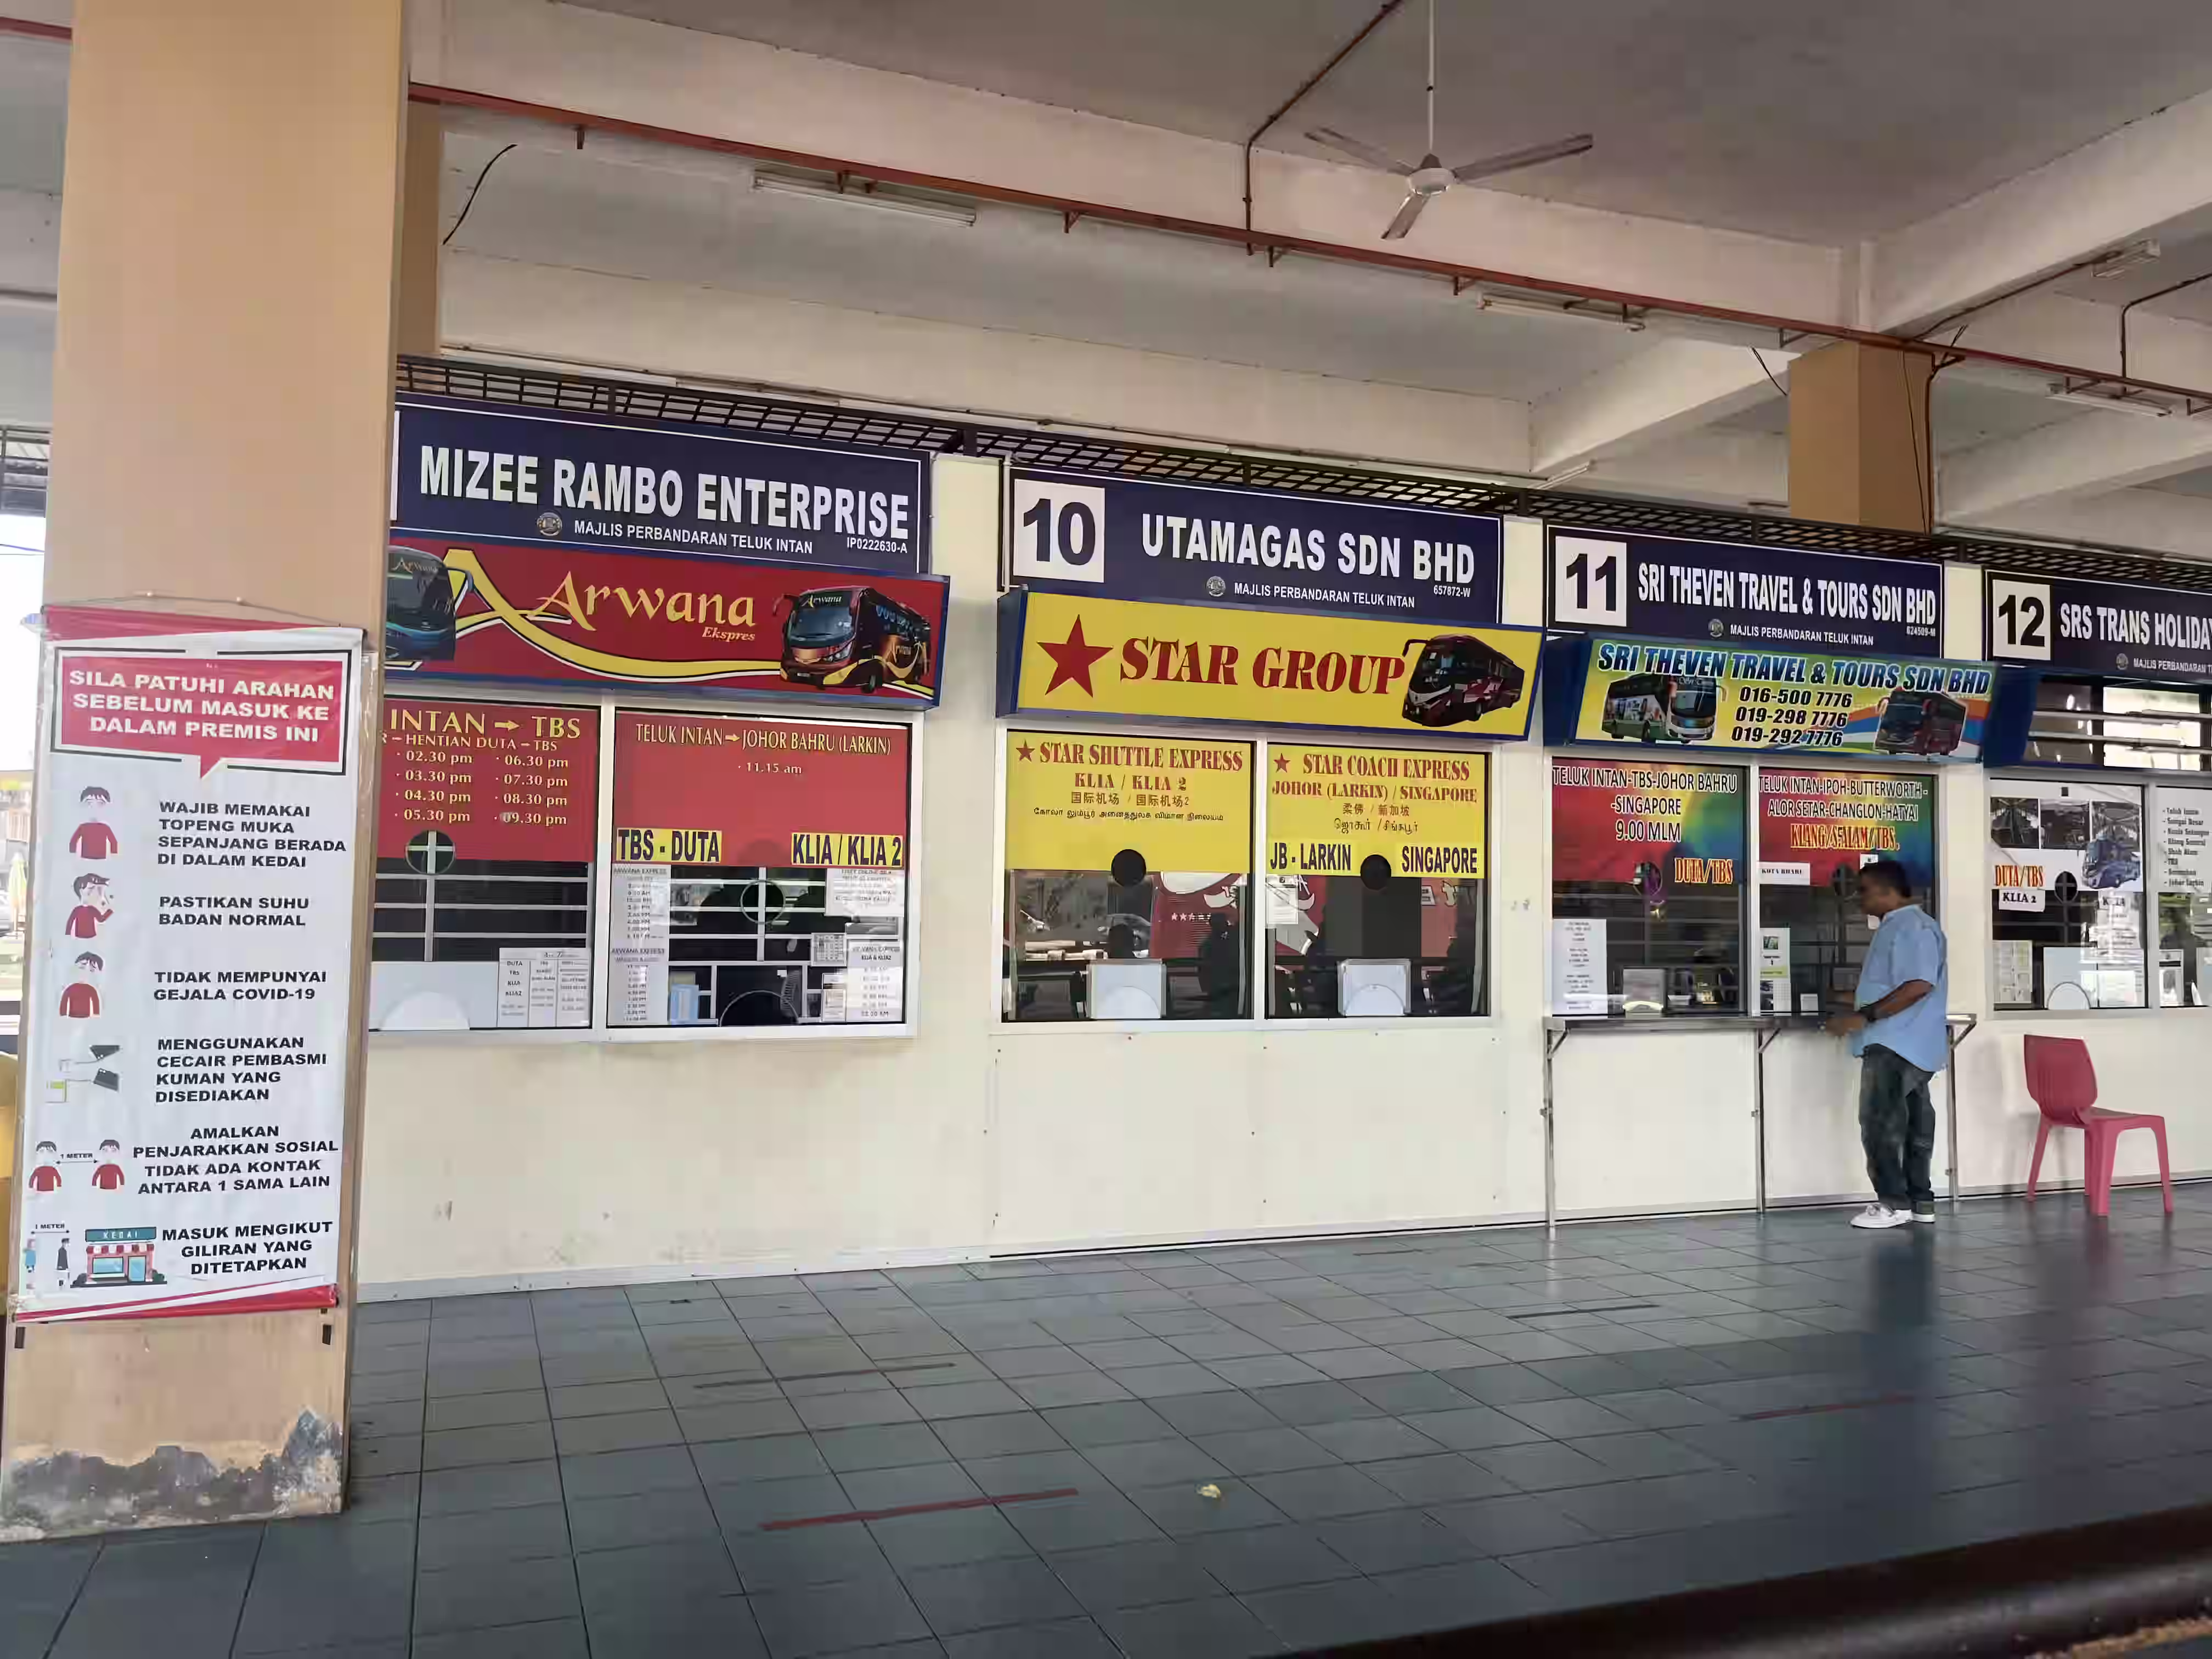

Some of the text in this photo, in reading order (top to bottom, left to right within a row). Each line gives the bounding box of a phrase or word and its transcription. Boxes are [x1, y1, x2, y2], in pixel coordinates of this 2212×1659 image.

[420, 444, 909, 540] MIZEE RAMBO ENTERPRISE
[574, 520, 813, 554] MAJLIS PERBANDARAN TELUK INTAN
[1023, 498, 1096, 566] 10
[847, 537, 907, 554] IP0222630-A
[1142, 513, 1475, 584] UTAMAGAS SDN BHD
[1433, 585, 1470, 597] 657872-W
[1566, 552, 1617, 612] 11
[526, 570, 757, 631] Arwana
[1234, 582, 1415, 608] MAJLIS PERBANDARAN TELUK INTAN
[1638, 562, 1936, 625] SRI THEVEN TRAVEL & TOURS SDN BHD
[1997, 595, 2045, 647] 12
[2060, 603, 2092, 639] SRS
[2097, 607, 2149, 645] TRANS
[702, 627, 755, 642] Ekspres
[1730, 623, 1873, 646] MAJLIS PERBANDARAN TELUK INTAN
[1120, 636, 1406, 695] STAR GROUP
[1598, 642, 1990, 695] SRI THEVEN TRAVEL & TOURS SDN BHD
[2134, 658, 2156, 669] MAJLIS
[2158, 660, 2205, 673] PERBANDARAN
[70, 670, 334, 700] SILA PATUHI ARAHAN
[73, 693, 329, 721] SEBELUM MASUK KE
[1739, 686, 1852, 708] 016-500 7776
[390, 709, 581, 740] INTAN TBS
[1736, 706, 1848, 727] 019-298 7776
[90, 717, 318, 742] DALAM PREMIS INI
[636, 723, 891, 755] TELUK INTAN JOHOR BAHRU (LARKIN)
[1731, 726, 1843, 747] 019-292 7776
[406, 734, 558, 751] HENTIAN DUTA TBS
[406, 751, 473, 764] 02.30 pm
[505, 755, 568, 769] 06.30 pm
[1040, 742, 1243, 772] STAR SHUTTLE EXPRESS
[1304, 753, 1470, 781] STAR COACH EXPRESS
[405, 771, 472, 785] 03.30 pm
[747, 762, 803, 775] 11.15 am
[504, 774, 568, 788] 07.30 pm
[1075, 773, 1186, 791] KLIA KLIA 2
[1553, 767, 1589, 786] TELUK
[1697, 774, 1737, 794] BAHRU
[1759, 776, 1788, 793] TELUK
[405, 791, 471, 804] 04.30 pm
[503, 793, 567, 808] 08.30 pm
[1071, 792, 1119, 804] 国际机场
[1272, 781, 1477, 803] JOHOR (LARKIN) SINGAPORE
[159, 802, 311, 817] WAJIB MEMAKAI
[404, 810, 471, 823] 05.30 pm
[1342, 803, 1409, 816] 柔佛 新加坡
[1768, 799, 1794, 817] ALOR
[545, 816, 567, 827] pm
[1616, 820, 1681, 842] 9.00 MLM
[158, 836, 347, 851] SEPANJANG BERADA
[618, 829, 720, 862] TBS DUTA
[793, 833, 901, 865] KLIA KLIA 2
[1271, 842, 1351, 871] JB LARKIN
[1402, 845, 1477, 873] SINGAPORE
[1995, 865, 2044, 887] DUTA/TBS
[2003, 893, 2029, 902] KLIA
[154, 989, 315, 1001] GEJALA COVID-19
[190, 1126, 279, 1139] AMALKAN
[133, 1140, 338, 1159] PENJARAKKAN SOSIAL
[162, 1221, 333, 1241] MASUK MENGIKUT
